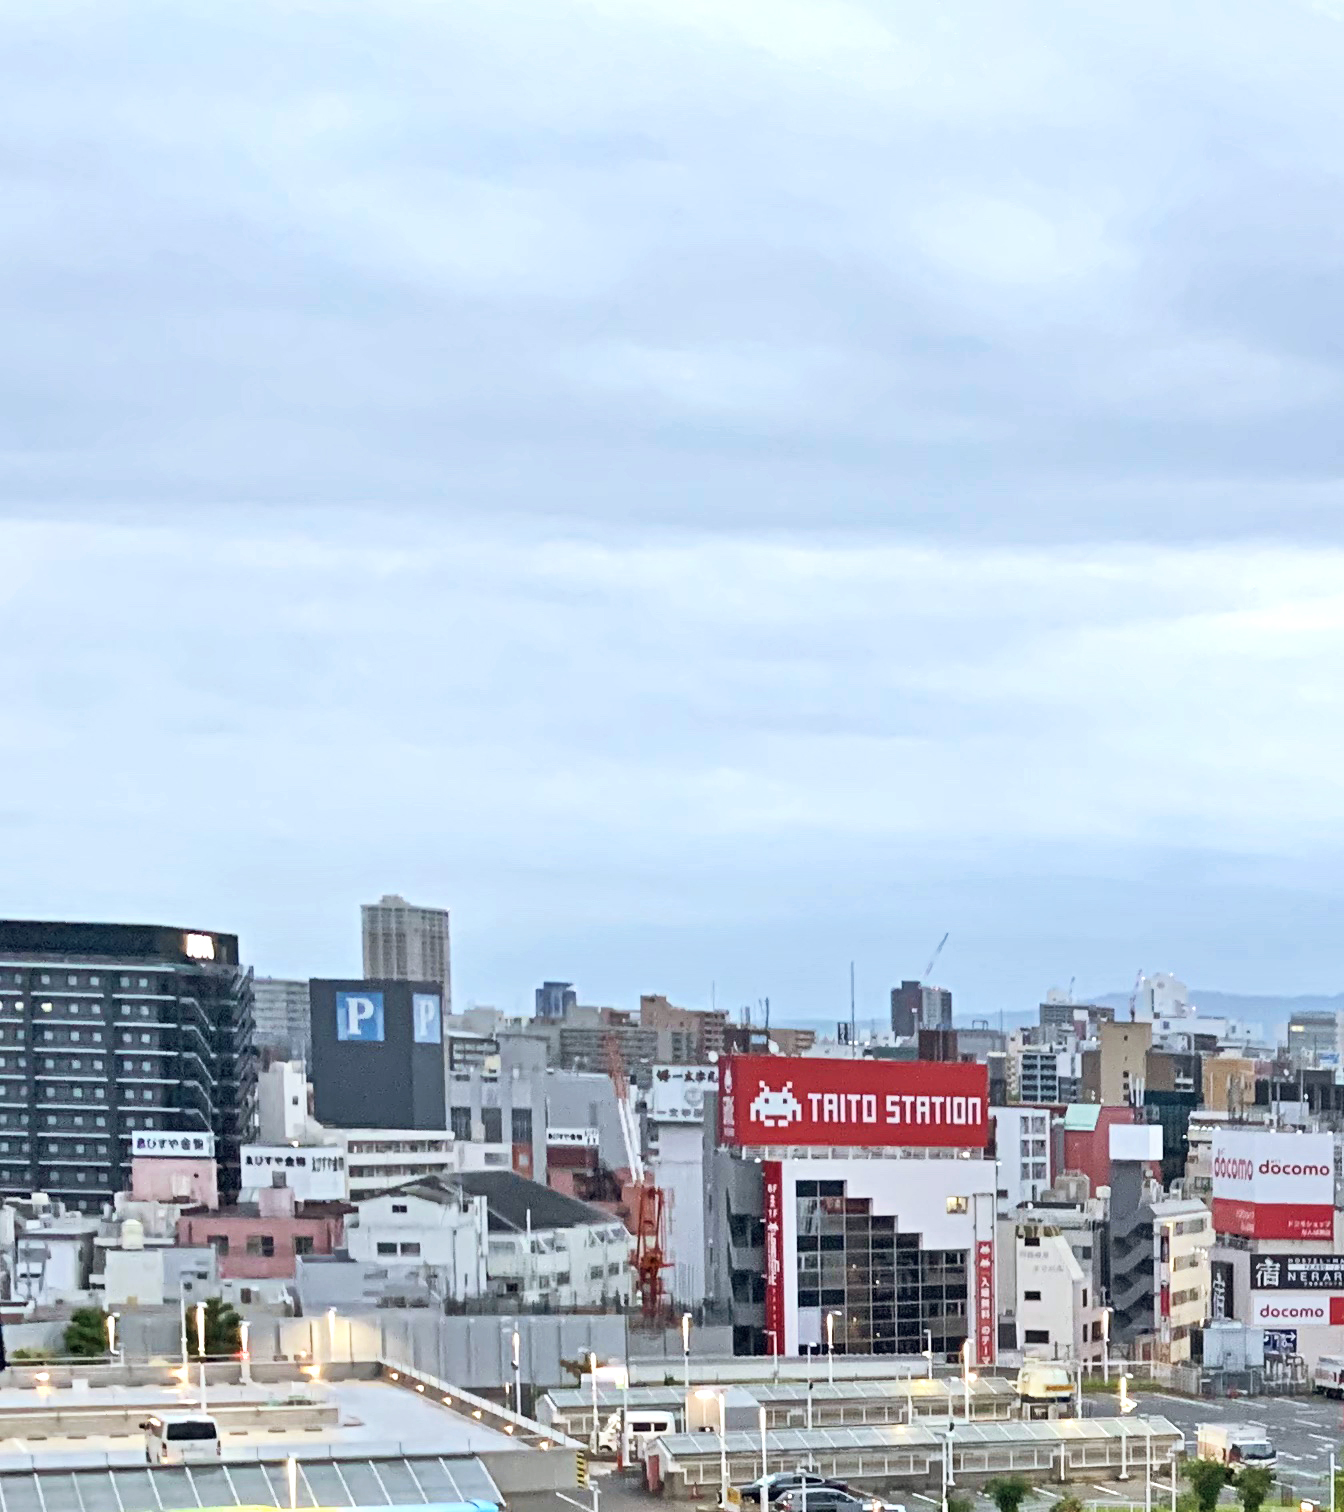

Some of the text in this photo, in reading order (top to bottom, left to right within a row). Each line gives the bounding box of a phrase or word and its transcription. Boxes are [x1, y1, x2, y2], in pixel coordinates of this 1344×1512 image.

[345, 997, 374, 1035] P
[419, 999, 435, 1037] P
[807, 1093, 981, 1125] TAITO STATION
[1214, 1149, 1254, 1181] docomo
[1258, 1160, 1330, 1176] docomo
[1255, 1256, 1281, 1287] 宿
[1260, 1304, 1324, 1318] docomo
